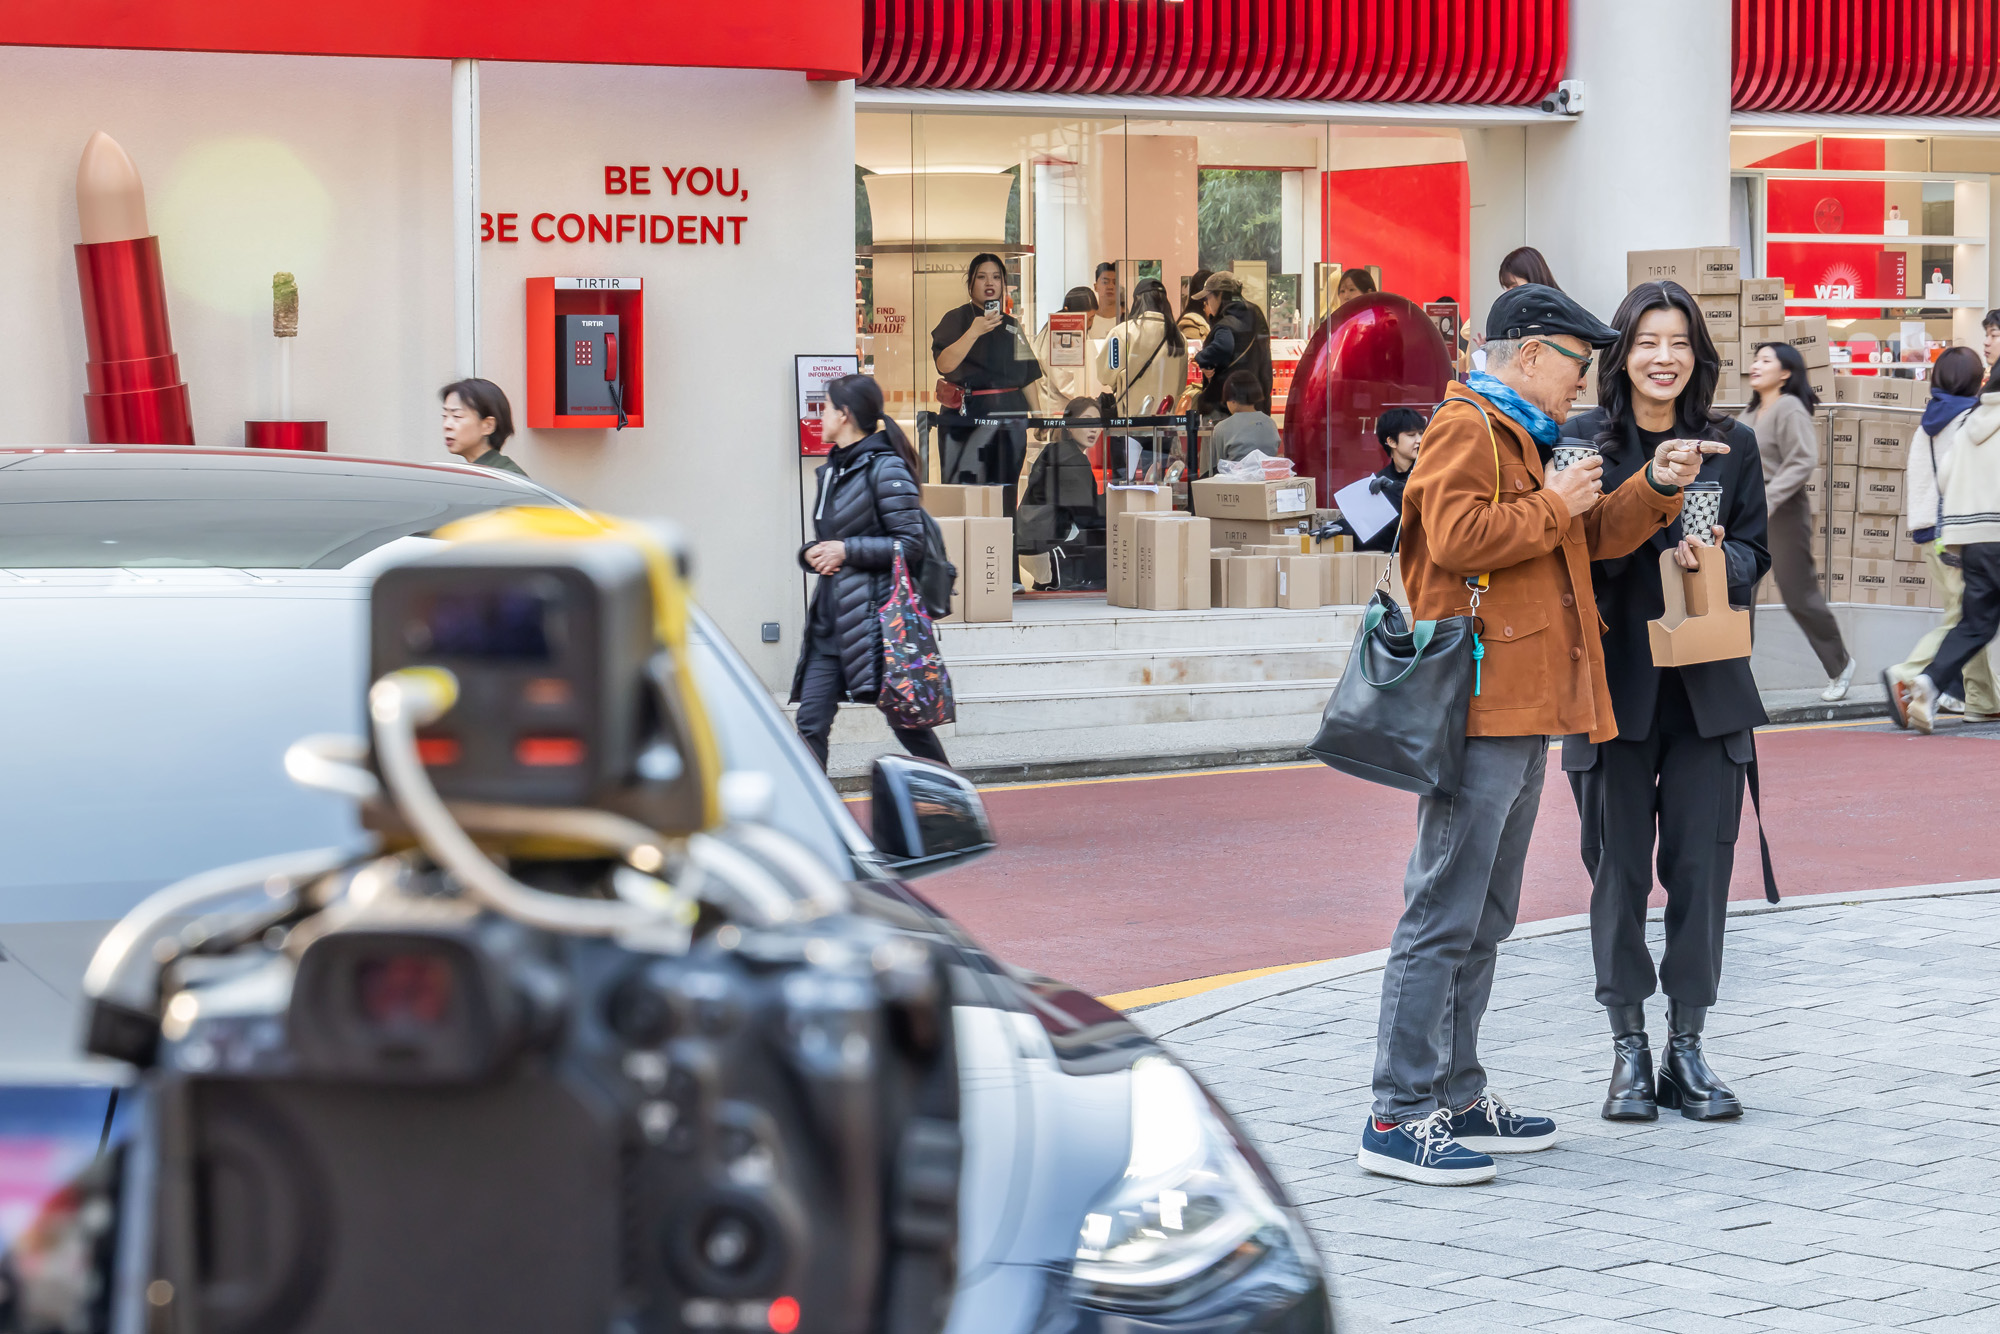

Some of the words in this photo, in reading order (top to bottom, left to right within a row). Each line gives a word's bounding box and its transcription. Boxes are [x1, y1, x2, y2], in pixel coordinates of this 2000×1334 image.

[604, 166, 651, 195] BE
[662, 166, 748, 201] YOU,
[481, 213, 519, 242] BE
[531, 213, 748, 245] CONFIDENT
[1648, 265, 1677, 276] TIRTIR
[1896, 256, 1904, 296] TIRTIR
[576, 279, 620, 288] TIRTIR
[876, 307, 895, 315] FIND
[884, 315, 906, 323] YOUR
[867, 323, 904, 334] SHADE
[974, 418, 998, 426] TIRTIR
[1216, 494, 1240, 503] TIRTIR
[1225, 532, 1248, 540] TIRTIR
[986, 546, 995, 594] TIRTIR
